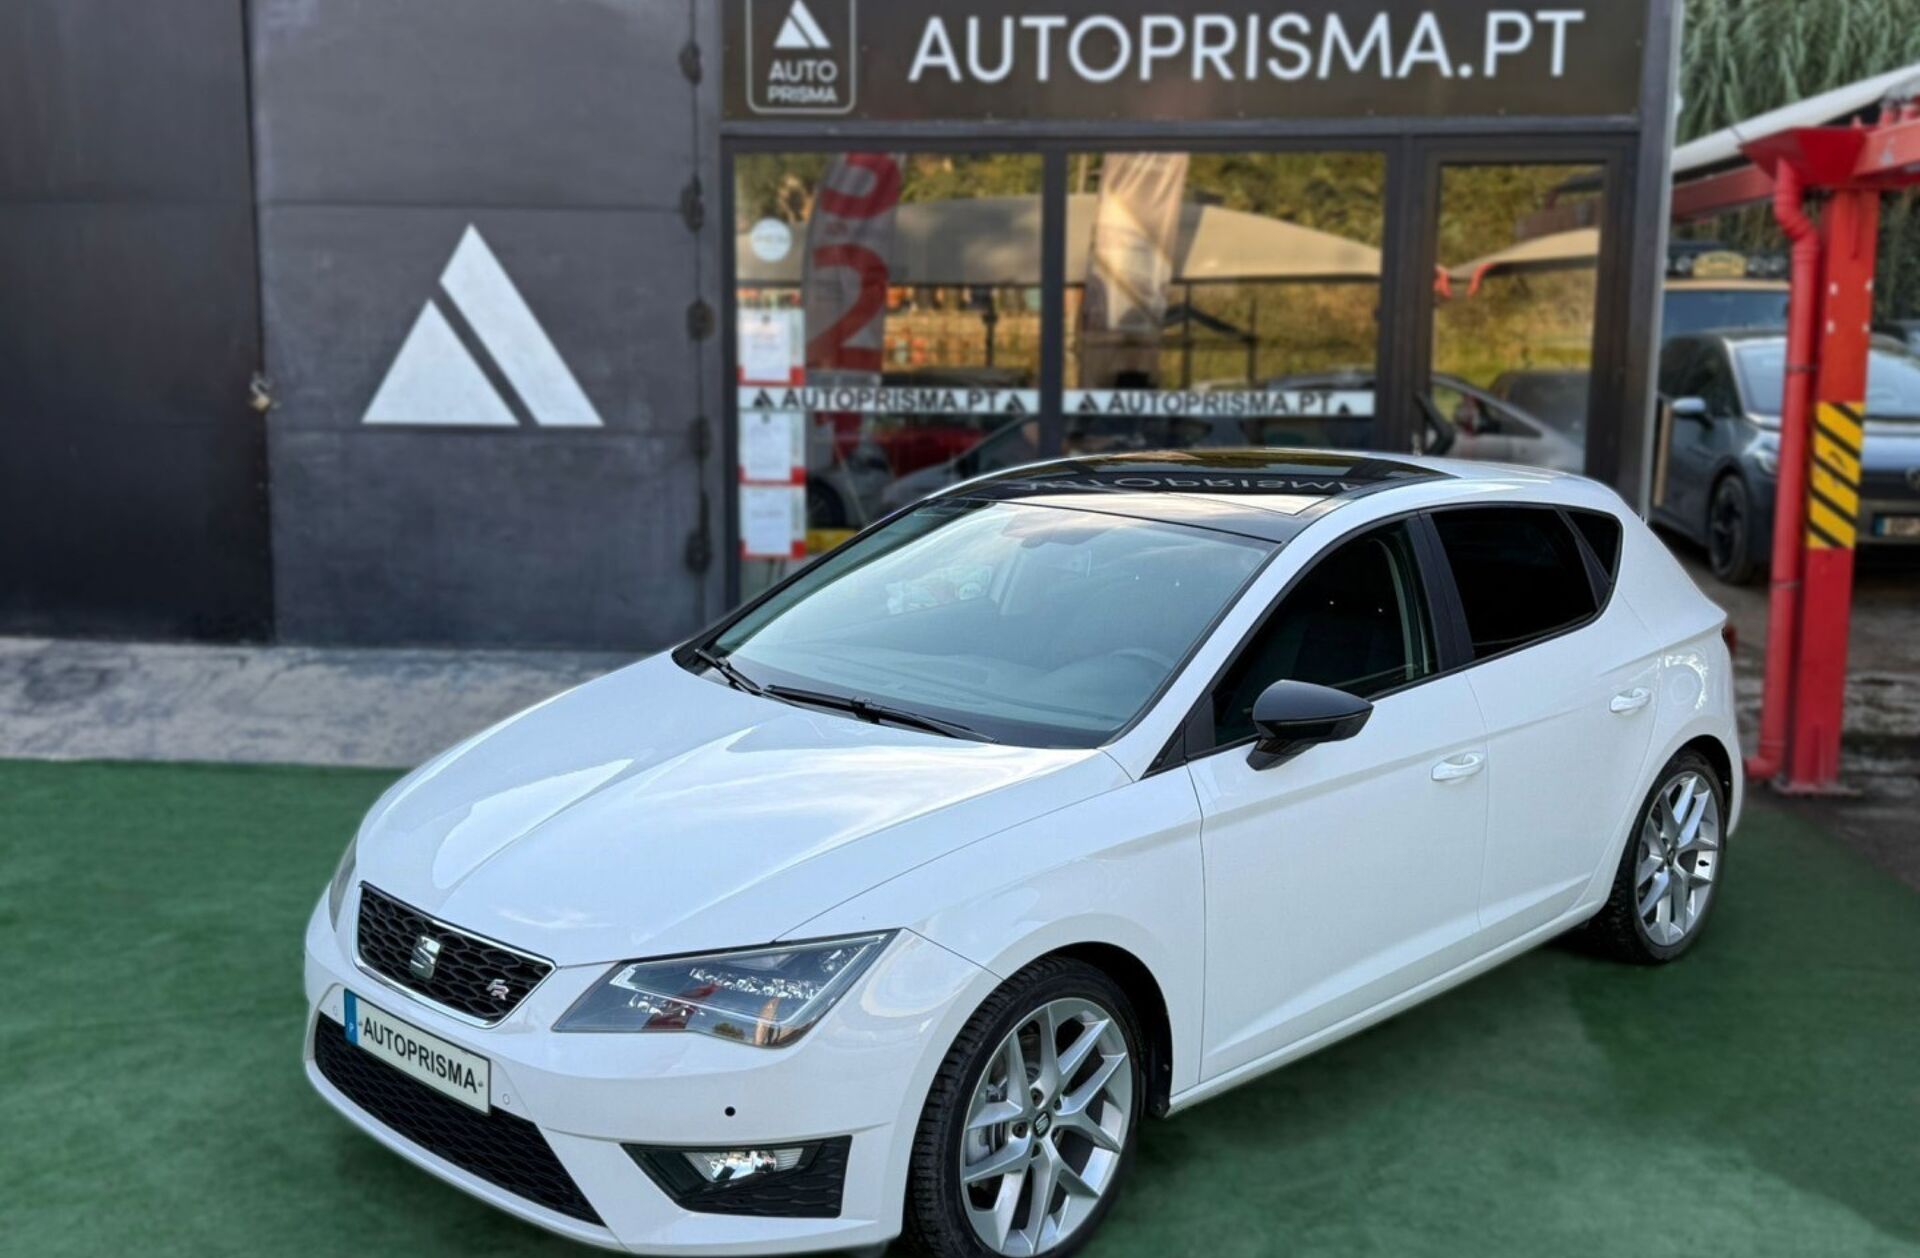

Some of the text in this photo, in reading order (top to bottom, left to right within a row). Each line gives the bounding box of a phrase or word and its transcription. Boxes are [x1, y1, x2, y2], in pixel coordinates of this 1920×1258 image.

[908, 11, 1586, 81] AUTOPRISMA.PT
[768, 60, 838, 82] AUTO
[767, 85, 838, 103] PRISMA
[782, 389, 998, 410] AUTOPRISMA.PT
[1107, 393, 1334, 413] AUTOPRISMA.PT
[363, 1016, 477, 1093] AUTOPRISMA
